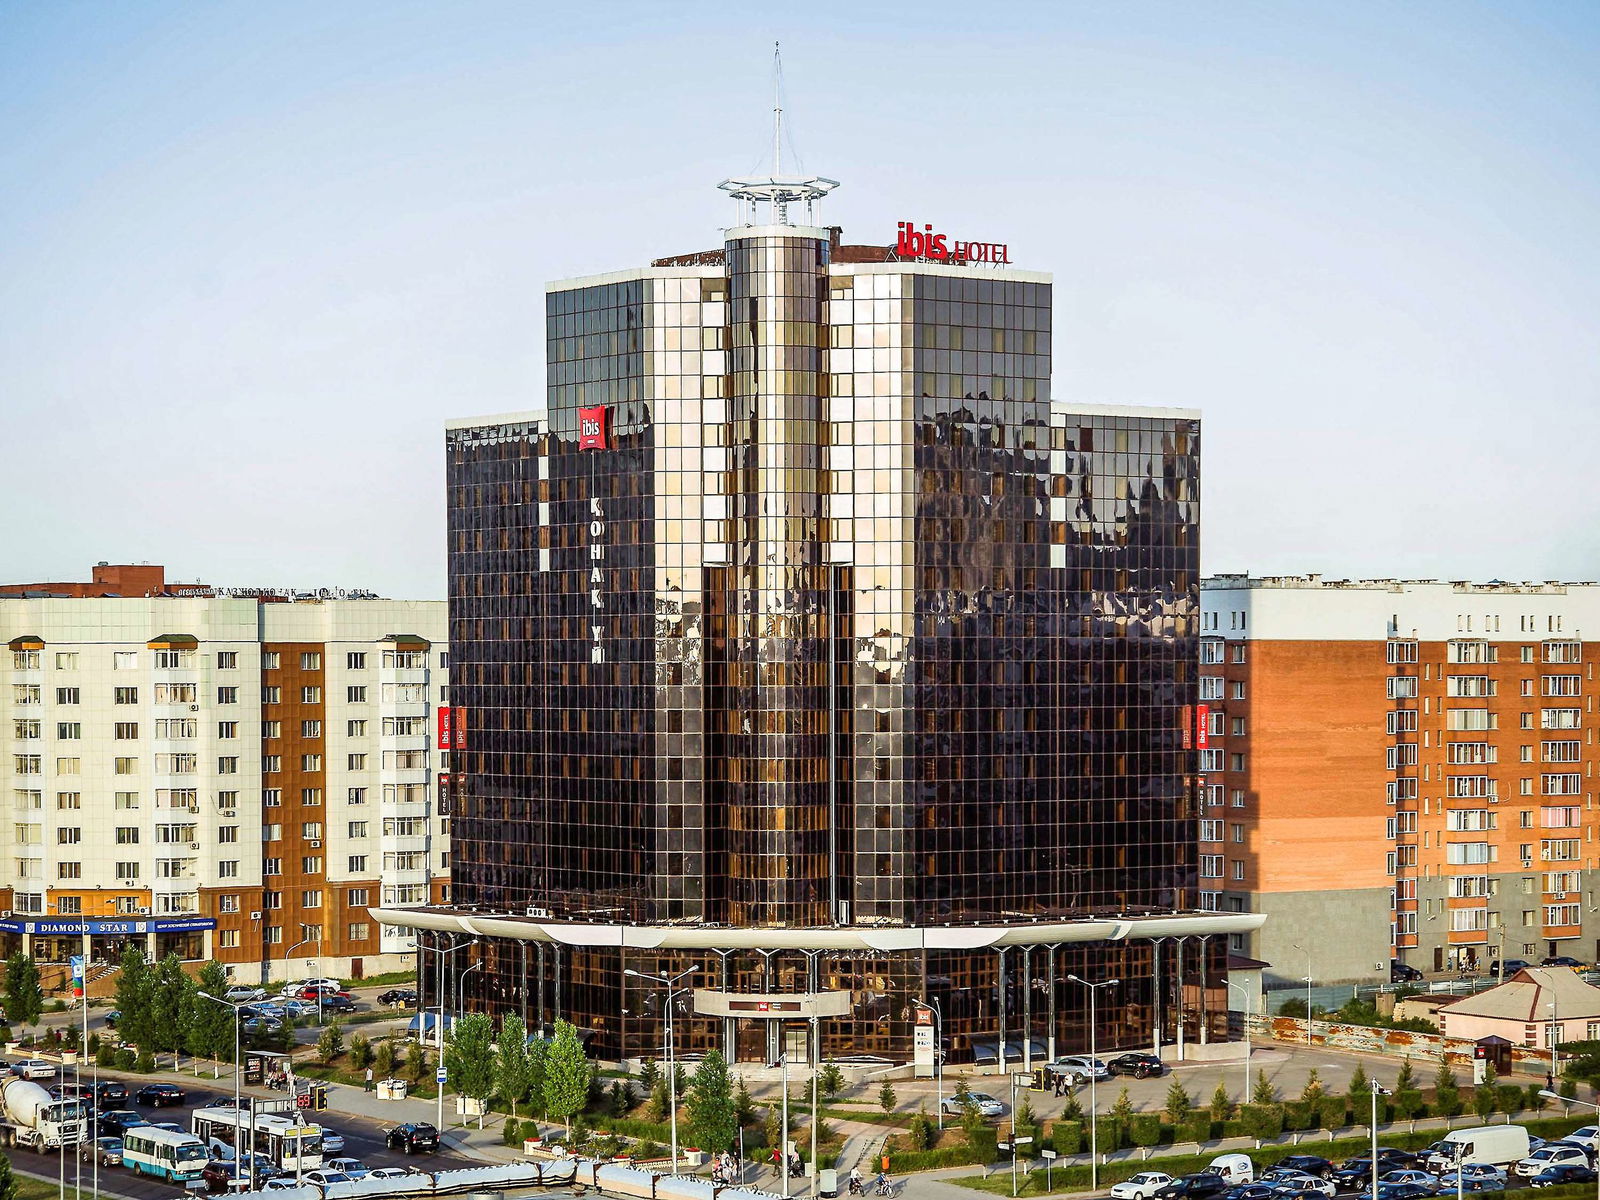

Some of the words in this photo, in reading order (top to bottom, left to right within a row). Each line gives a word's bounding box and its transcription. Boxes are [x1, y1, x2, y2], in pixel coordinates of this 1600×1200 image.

[896, 221, 948, 259] ibis
[954, 241, 1012, 264] HOTEL
[582, 418, 600, 437] ibis
[41, 924, 90, 932] DIAMOND
[99, 924, 128, 932] STAR
[297, 1095, 310, 1107] 69
